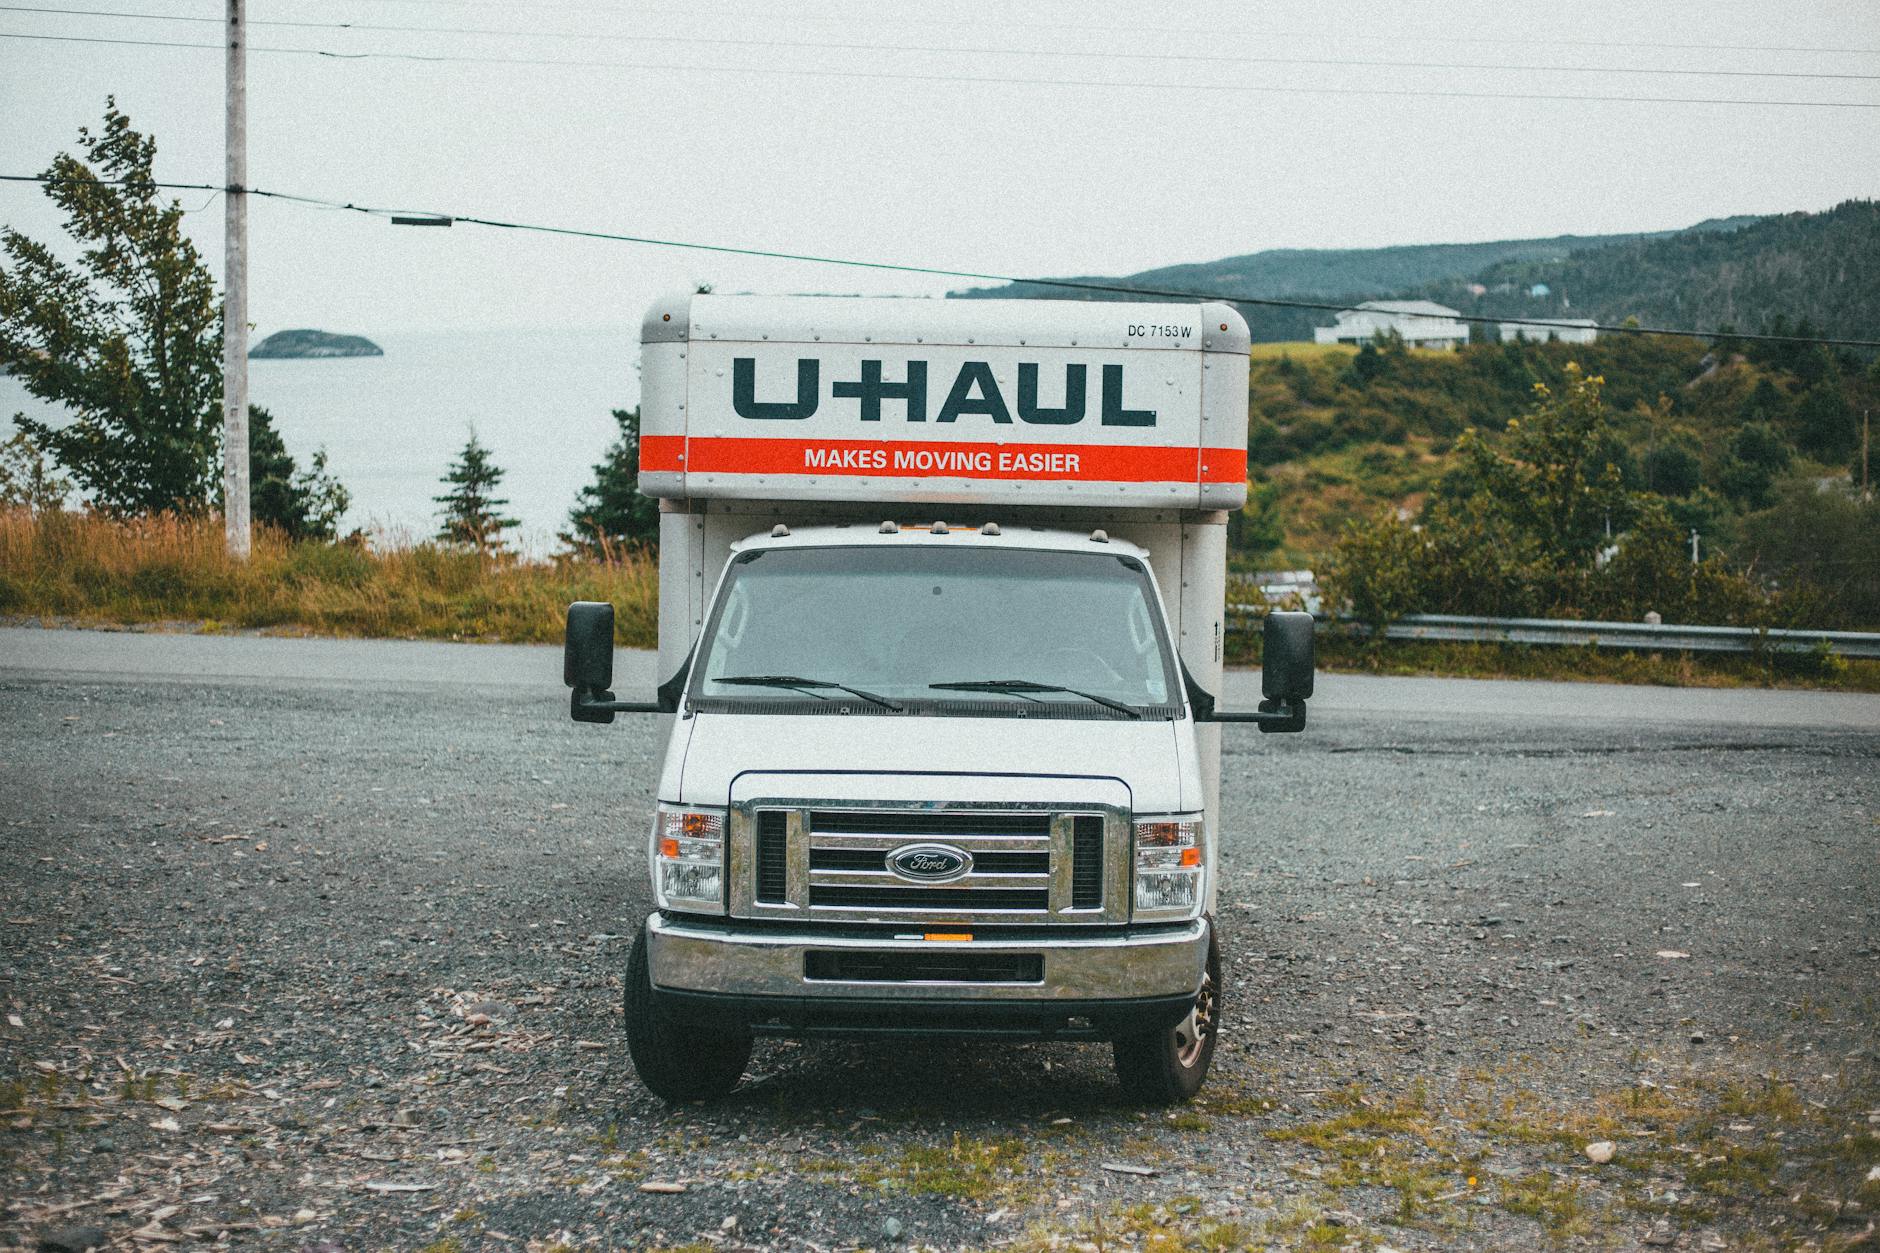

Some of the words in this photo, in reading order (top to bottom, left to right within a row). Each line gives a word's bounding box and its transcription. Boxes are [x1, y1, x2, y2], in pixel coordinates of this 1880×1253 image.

[1128, 324, 1145, 337] DC
[733, 357, 1157, 427] U-HAUL
[804, 448, 888, 469] MAKES
[893, 450, 992, 471] MOVING
[998, 452, 1081, 473] EASIER
[910, 853, 948, 870] Ford
